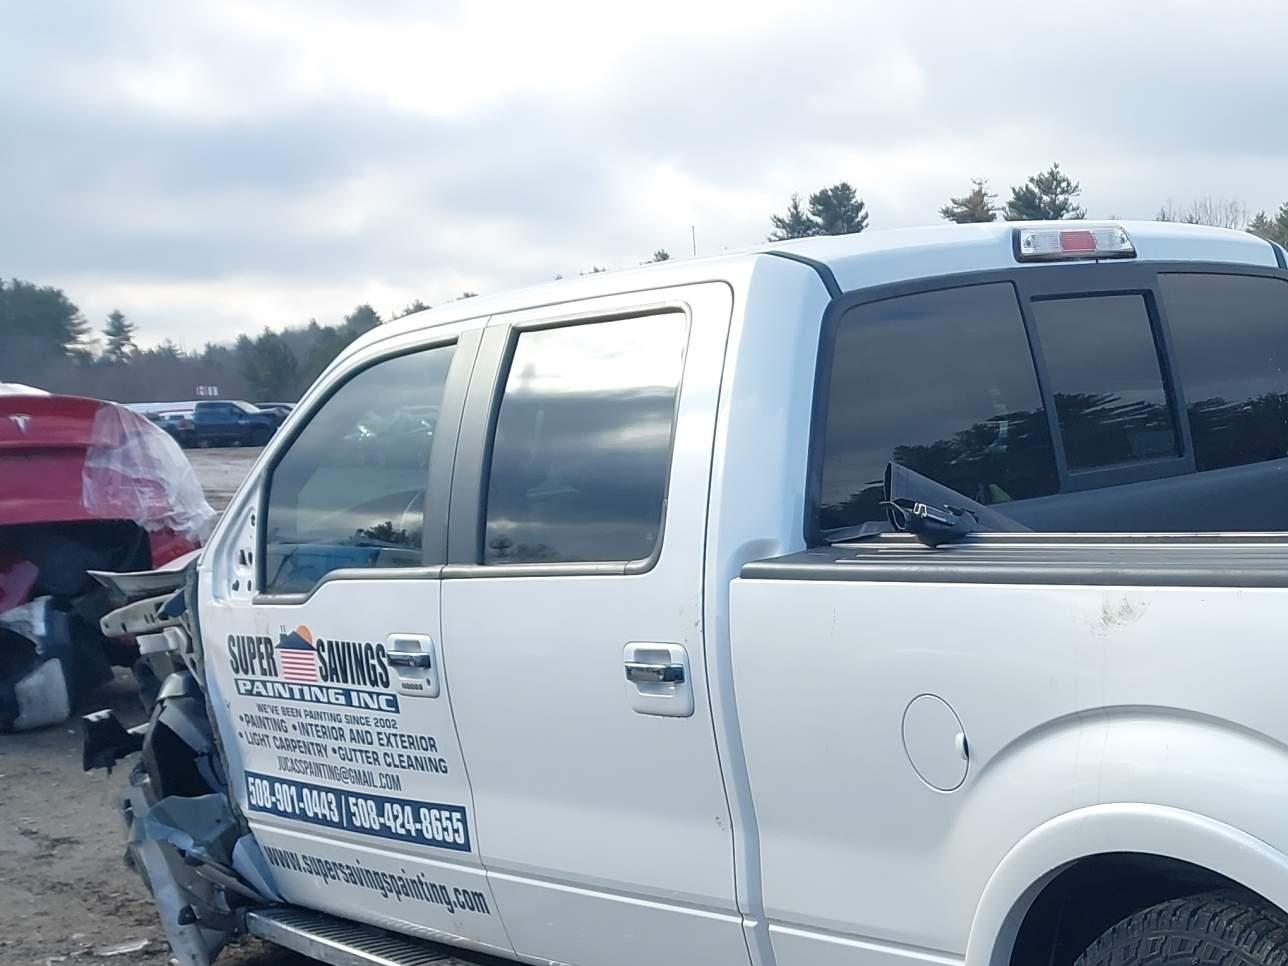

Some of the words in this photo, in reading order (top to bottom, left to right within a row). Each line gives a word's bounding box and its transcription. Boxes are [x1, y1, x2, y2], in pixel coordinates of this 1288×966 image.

[228, 635, 278, 677] SUPER
[317, 638, 390, 688] SAVINGS
[237, 680, 344, 704] PAINTING
[348, 691, 396, 711] INC
[256, 703, 279, 716] WE'VE
[281, 706, 302, 719] BEEN
[304, 709, 342, 724] PAINTING
[344, 714, 371, 727] SINCE
[373, 717, 398, 730] 2002
[244, 713, 288, 733] PAINTING
[297, 721, 346, 743] INTERIOR
[349, 728, 374, 746] AND
[376, 731, 438, 753] EXTERIOR
[245, 731, 272, 748] LIGHT
[272, 735, 329, 758] CARPENTRY
[338, 746, 381, 766] GUTTER
[382, 751, 448, 774] CLEANING
[247, 776, 340, 823] 508-901-0443
[349, 796, 466, 845] 508-424-8655
[264, 846, 491, 914] www.supersavingspainting.com
